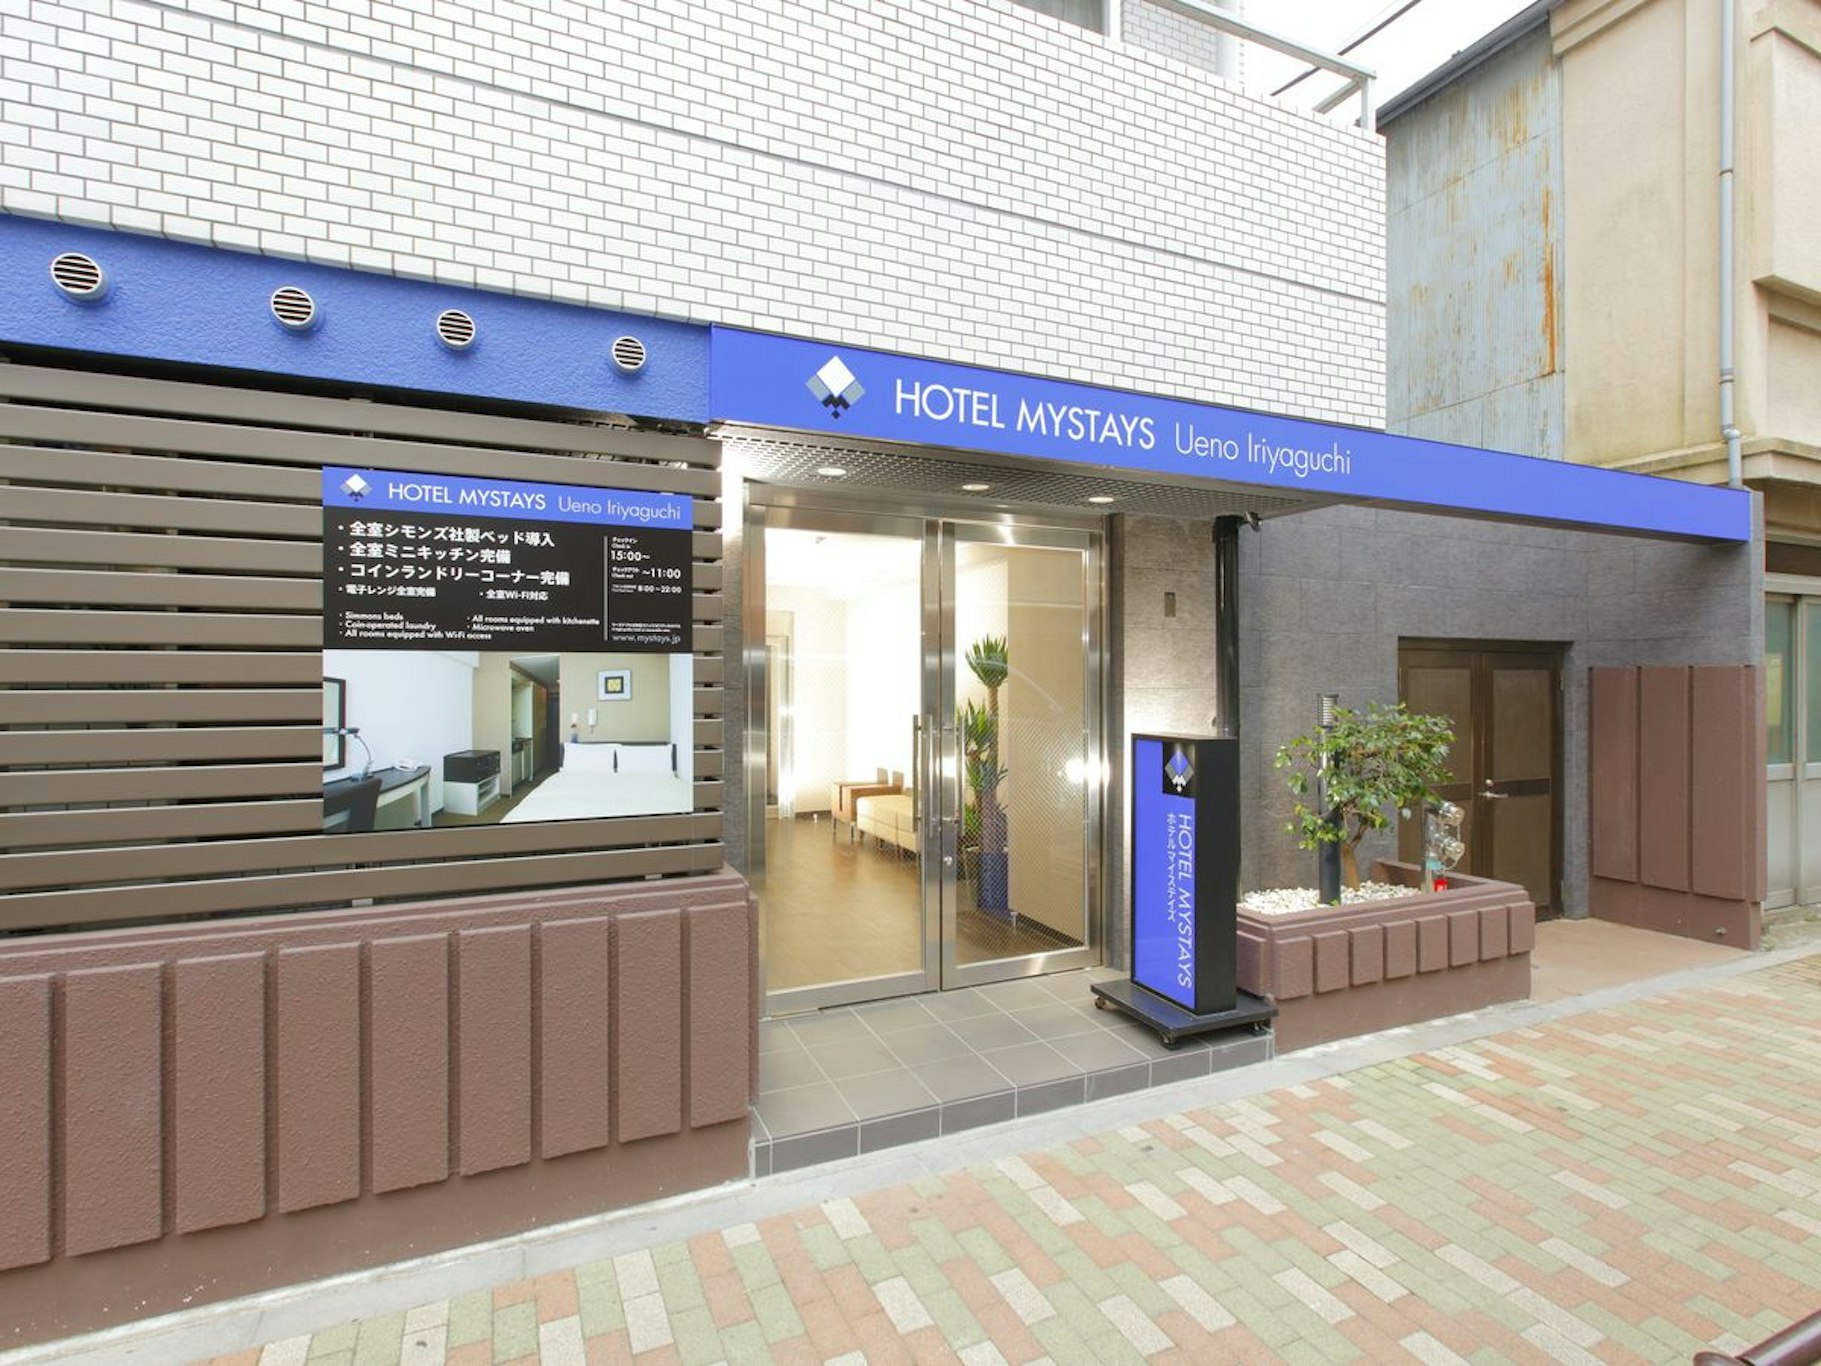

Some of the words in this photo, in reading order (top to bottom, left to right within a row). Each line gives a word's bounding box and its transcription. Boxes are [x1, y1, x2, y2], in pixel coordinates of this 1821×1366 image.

[895, 378, 1006, 429] HOTEL
[1016, 398, 1156, 450] MYSTAYS
[1175, 422, 1240, 461] Ueno
[1248, 432, 1351, 478] Iriyaguchi
[388, 482, 453, 504] HOTEL
[458, 488, 546, 511] MYSTAYS
[558, 495, 602, 515] Ueno
[607, 499, 681, 523] Iriyaguchi
[349, 520, 556, 548] 全室シモンズ社製ベッド導入
[349, 541, 512, 565] 全室ミニキッチン完備
[350, 563, 571, 587] コインランドリーコーナー完備
[471, 614, 484, 623] All
[345, 629, 358, 638] All
[1178, 813, 1193, 881] HOTEL
[1177, 887, 1193, 989] MYSTAYS
